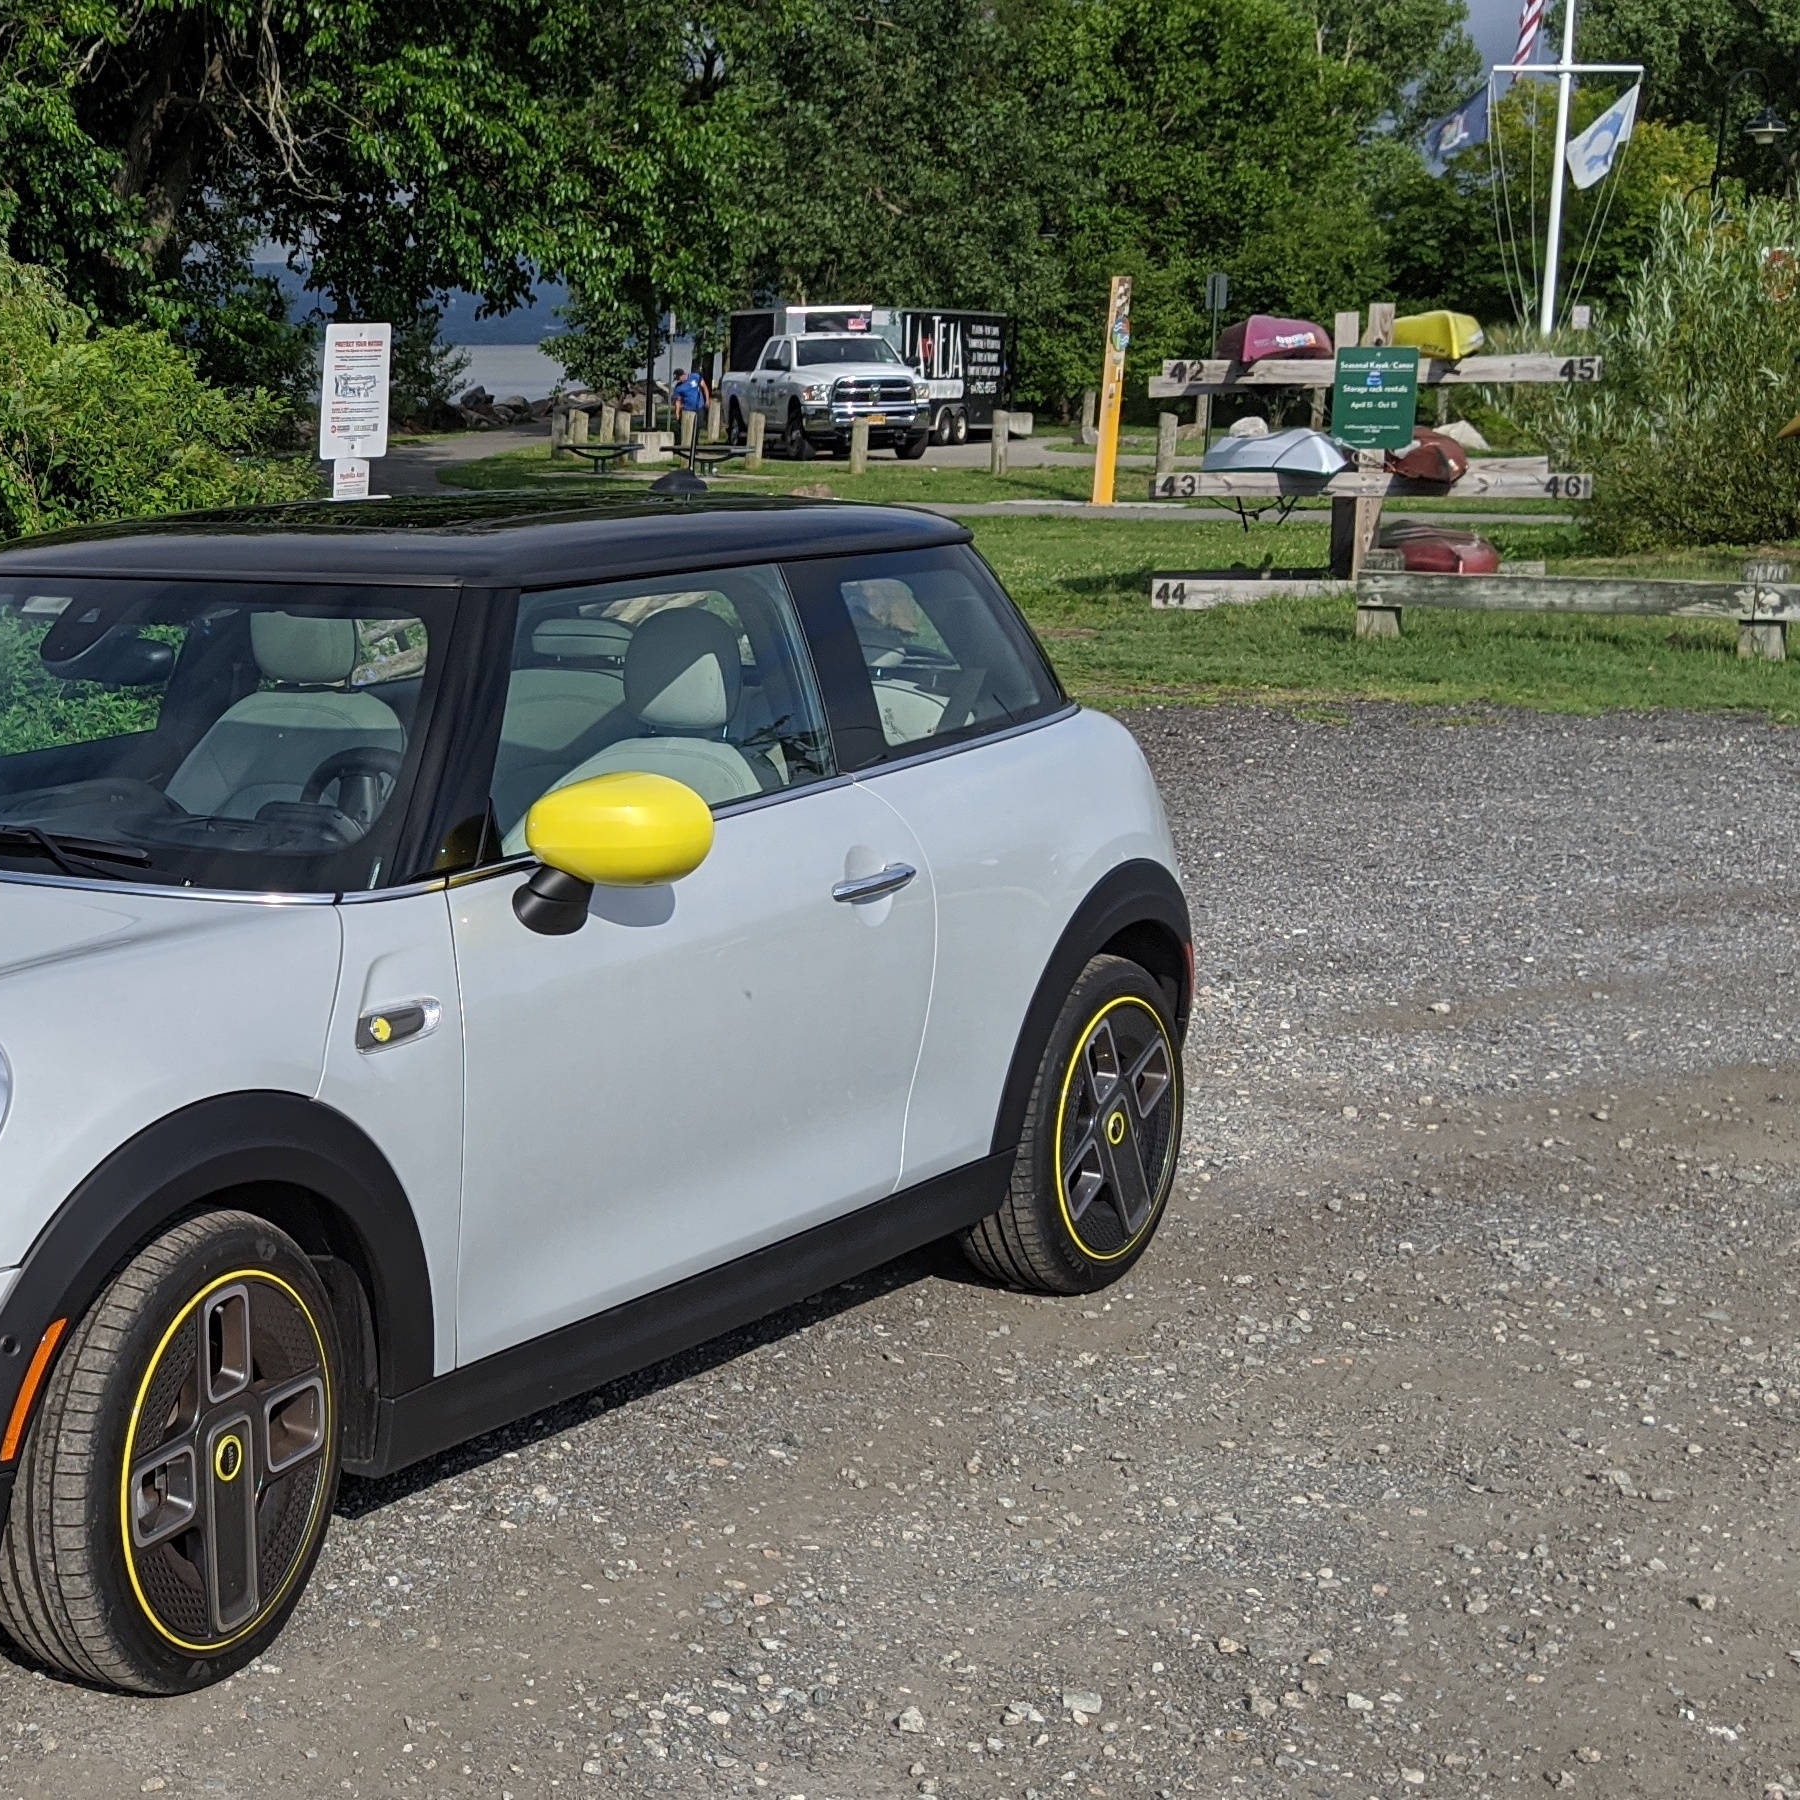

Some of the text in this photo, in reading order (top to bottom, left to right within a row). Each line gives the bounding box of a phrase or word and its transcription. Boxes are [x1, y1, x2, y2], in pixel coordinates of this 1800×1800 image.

[932, 316, 963, 378] TEJA
[1170, 361, 1204, 383] 42
[1340, 361, 1368, 369] Seasonal
[1559, 357, 1595, 382] 45
[1343, 384, 1367, 394] Storage
[1384, 385, 1408, 393] rentals
[1160, 474, 1196, 497] 43
[1544, 475, 1581, 499] 46
[1156, 582, 1186, 605] 44
